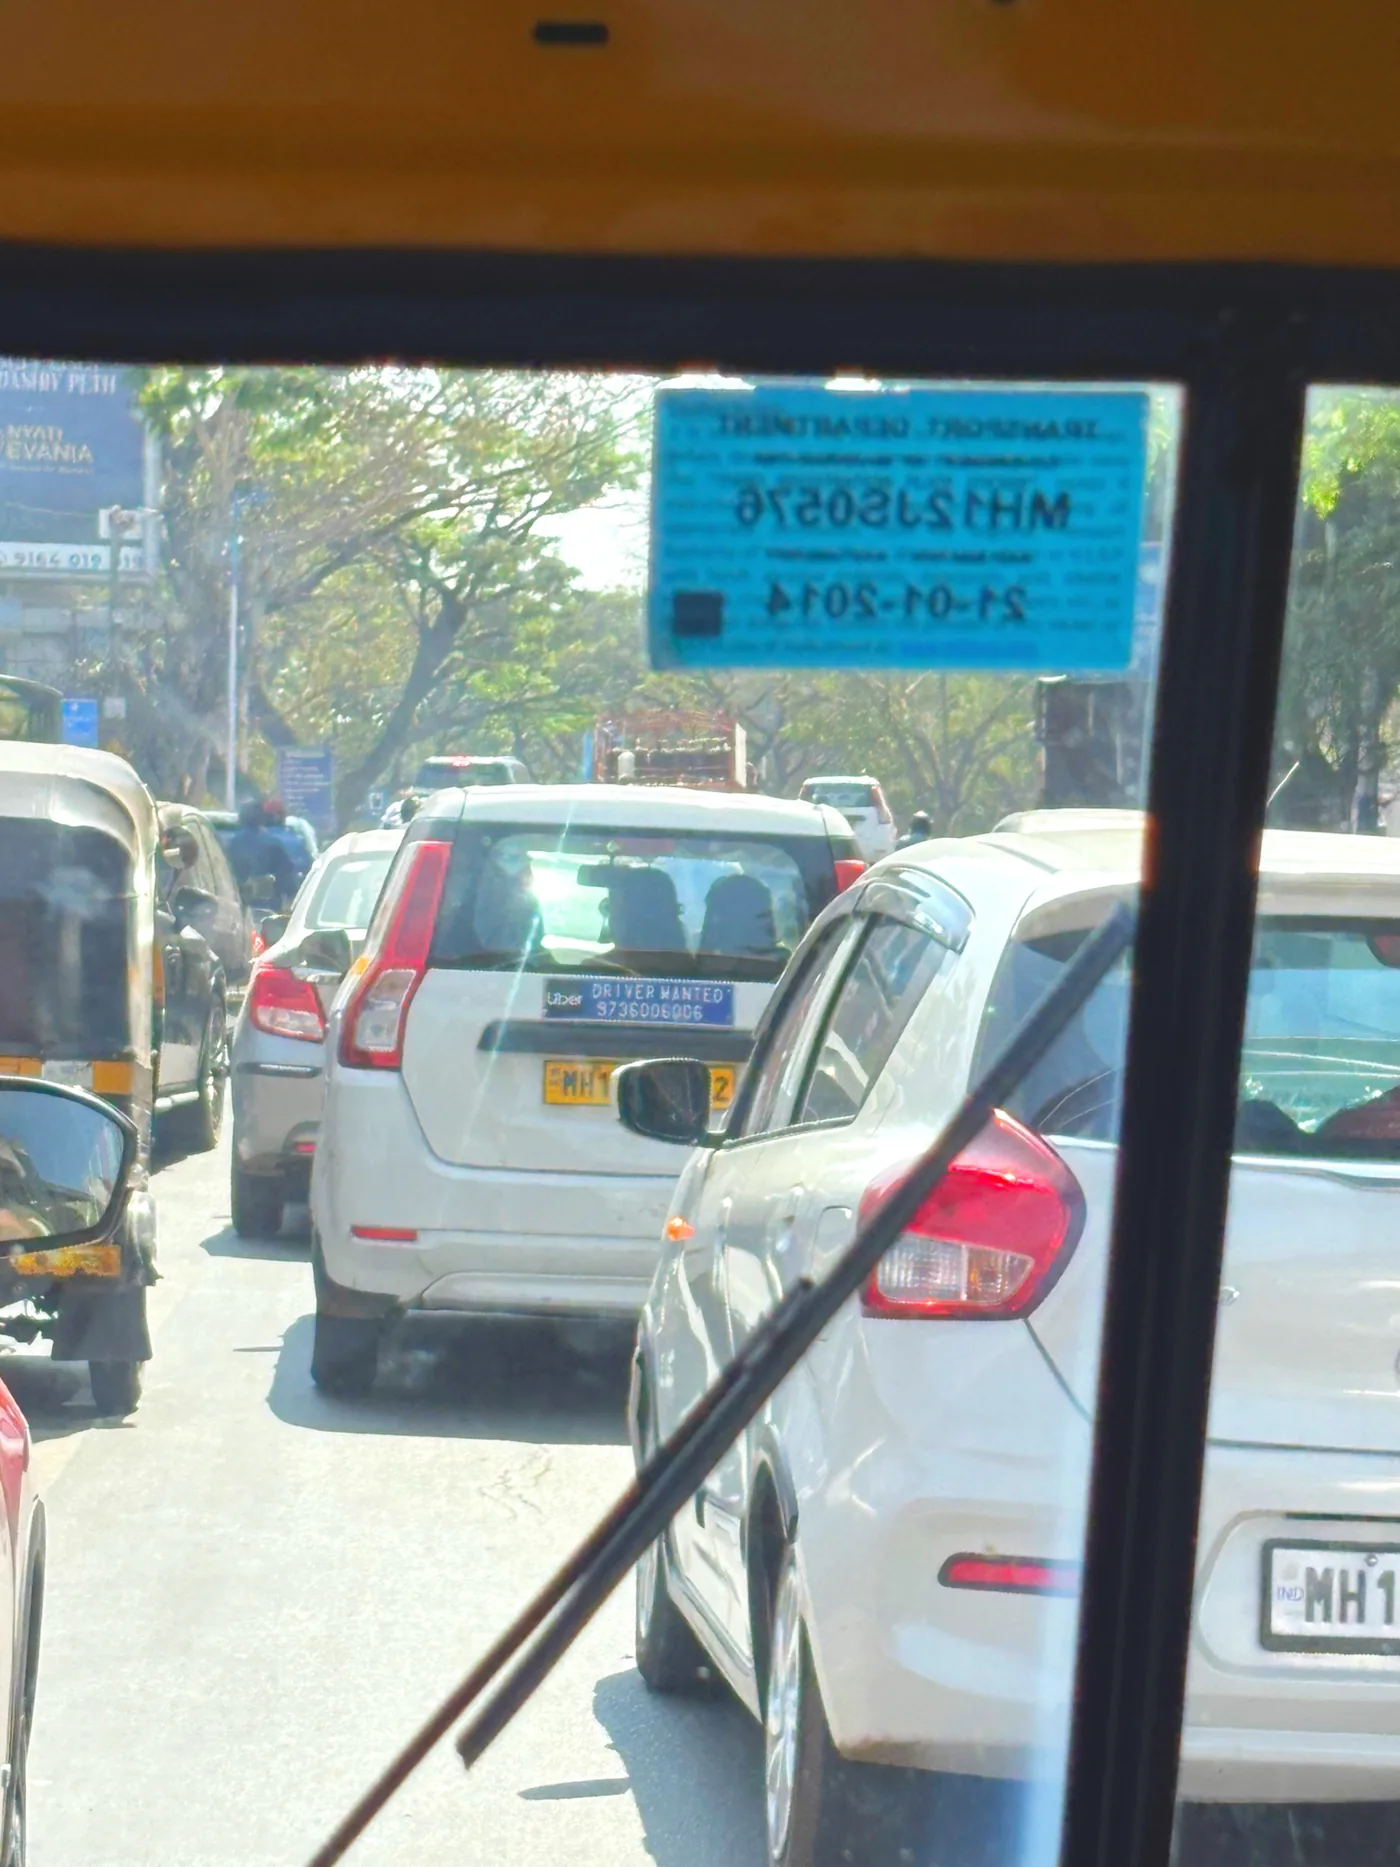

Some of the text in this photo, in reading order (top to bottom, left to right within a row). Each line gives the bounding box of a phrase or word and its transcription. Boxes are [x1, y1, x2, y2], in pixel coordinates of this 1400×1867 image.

[592, 983, 724, 1004] DRIVER WANTED
[1277, 1586, 1305, 1602] IND
